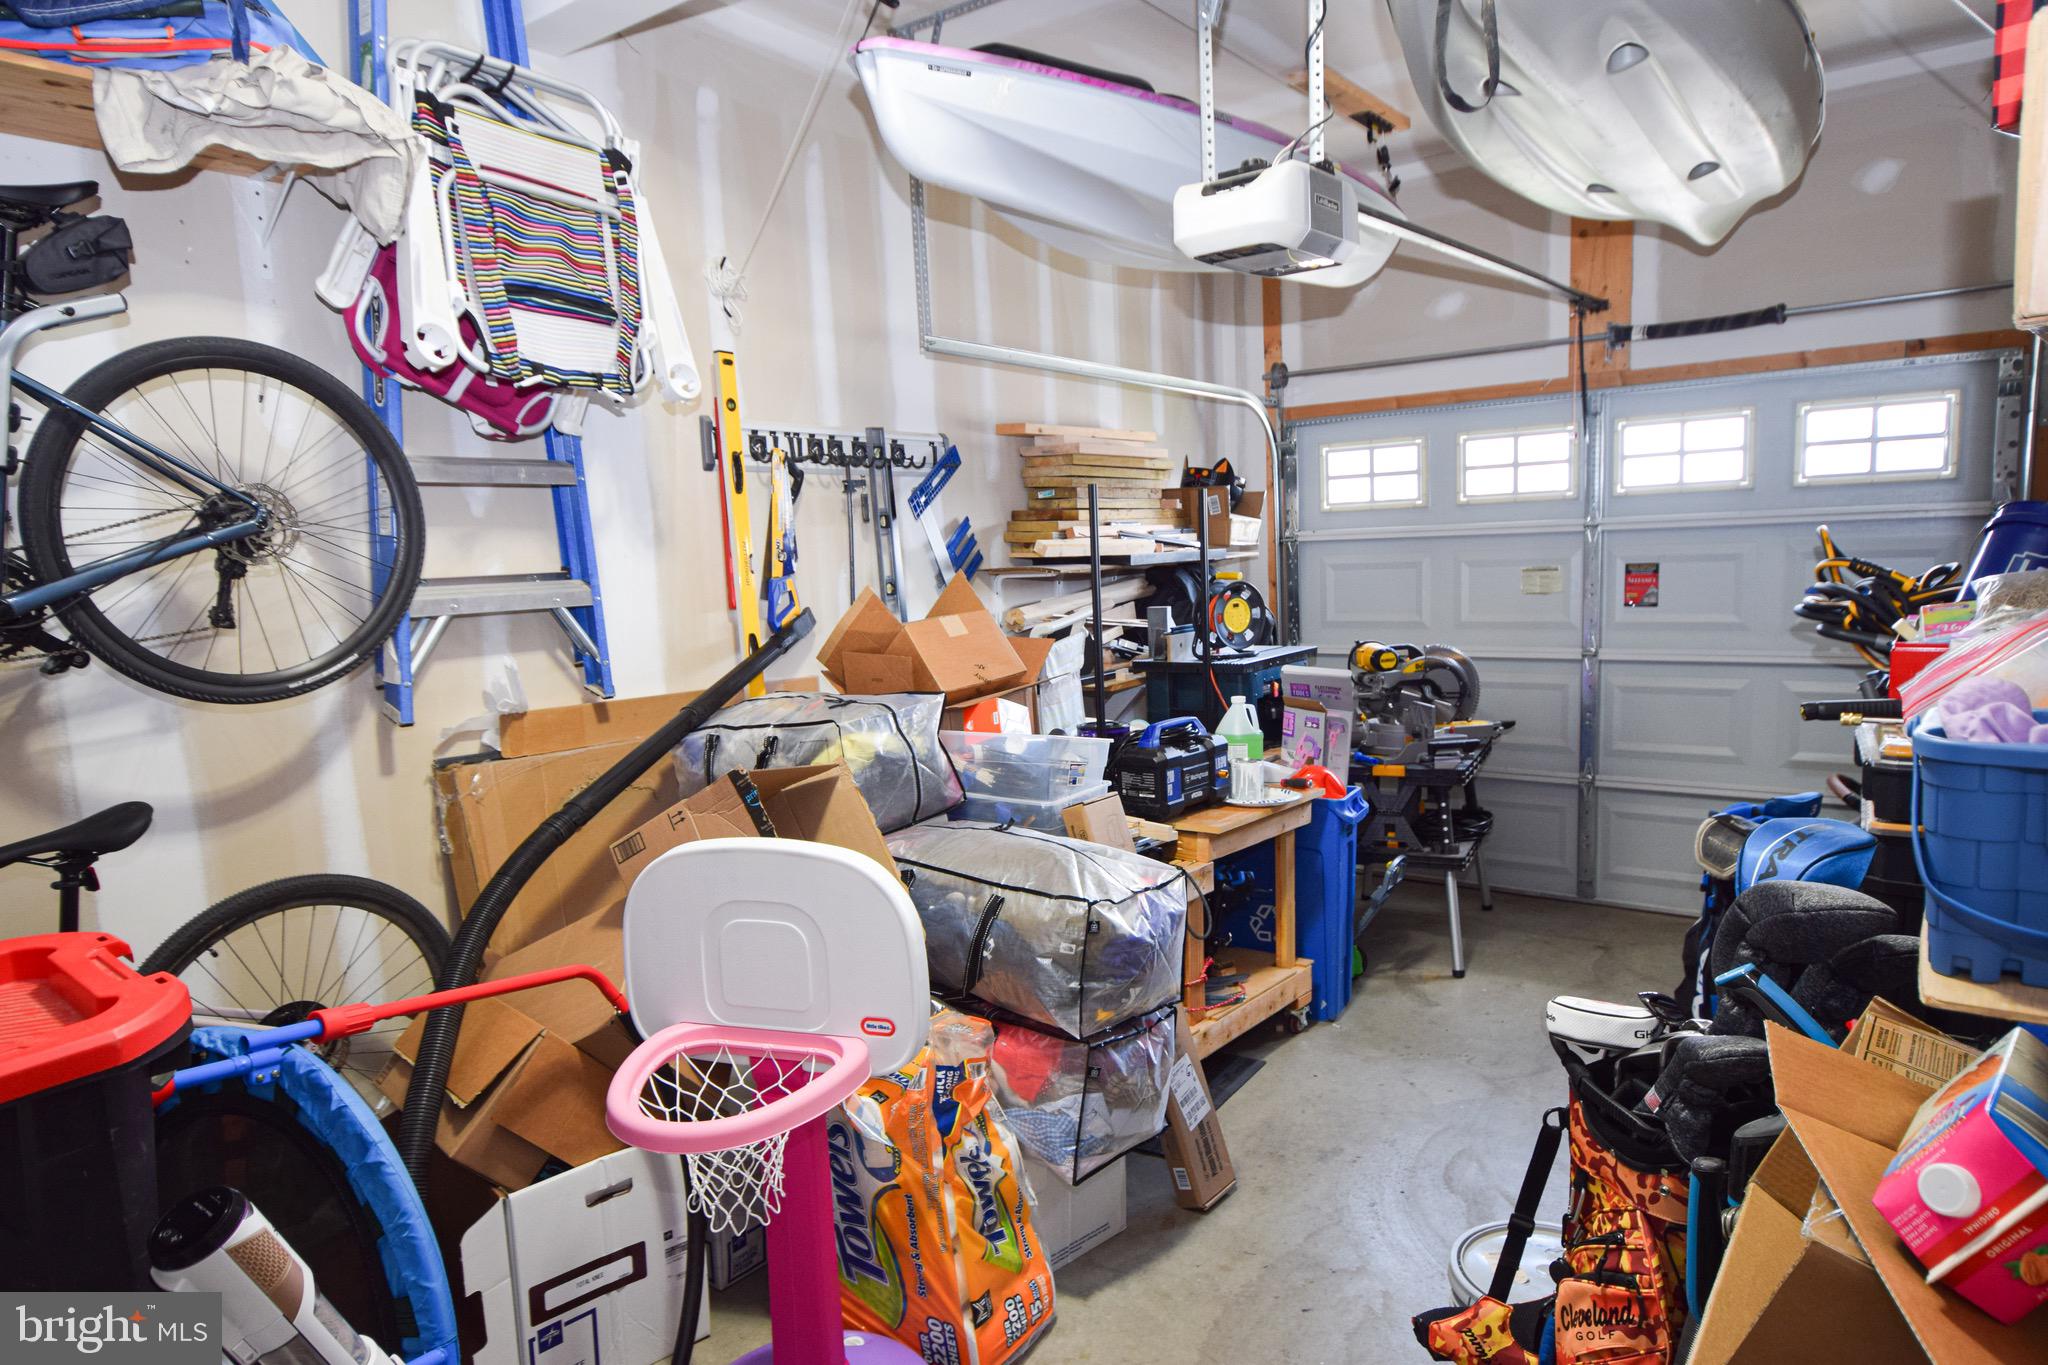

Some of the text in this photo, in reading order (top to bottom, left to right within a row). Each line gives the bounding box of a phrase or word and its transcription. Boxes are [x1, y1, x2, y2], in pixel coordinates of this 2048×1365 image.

[905, 1194, 919, 1250] Absorbent
[1963, 1206, 2001, 1237] ORIGINAL
[1020, 1224, 1033, 1259] Strong
[1986, 1226, 2033, 1259] ORIGINAL
[914, 1261, 928, 1299] Strong
[1561, 1296, 1635, 1331] Cleveland
[920, 1333, 934, 1364] OVER
[1576, 1330, 1615, 1341] GOLF
